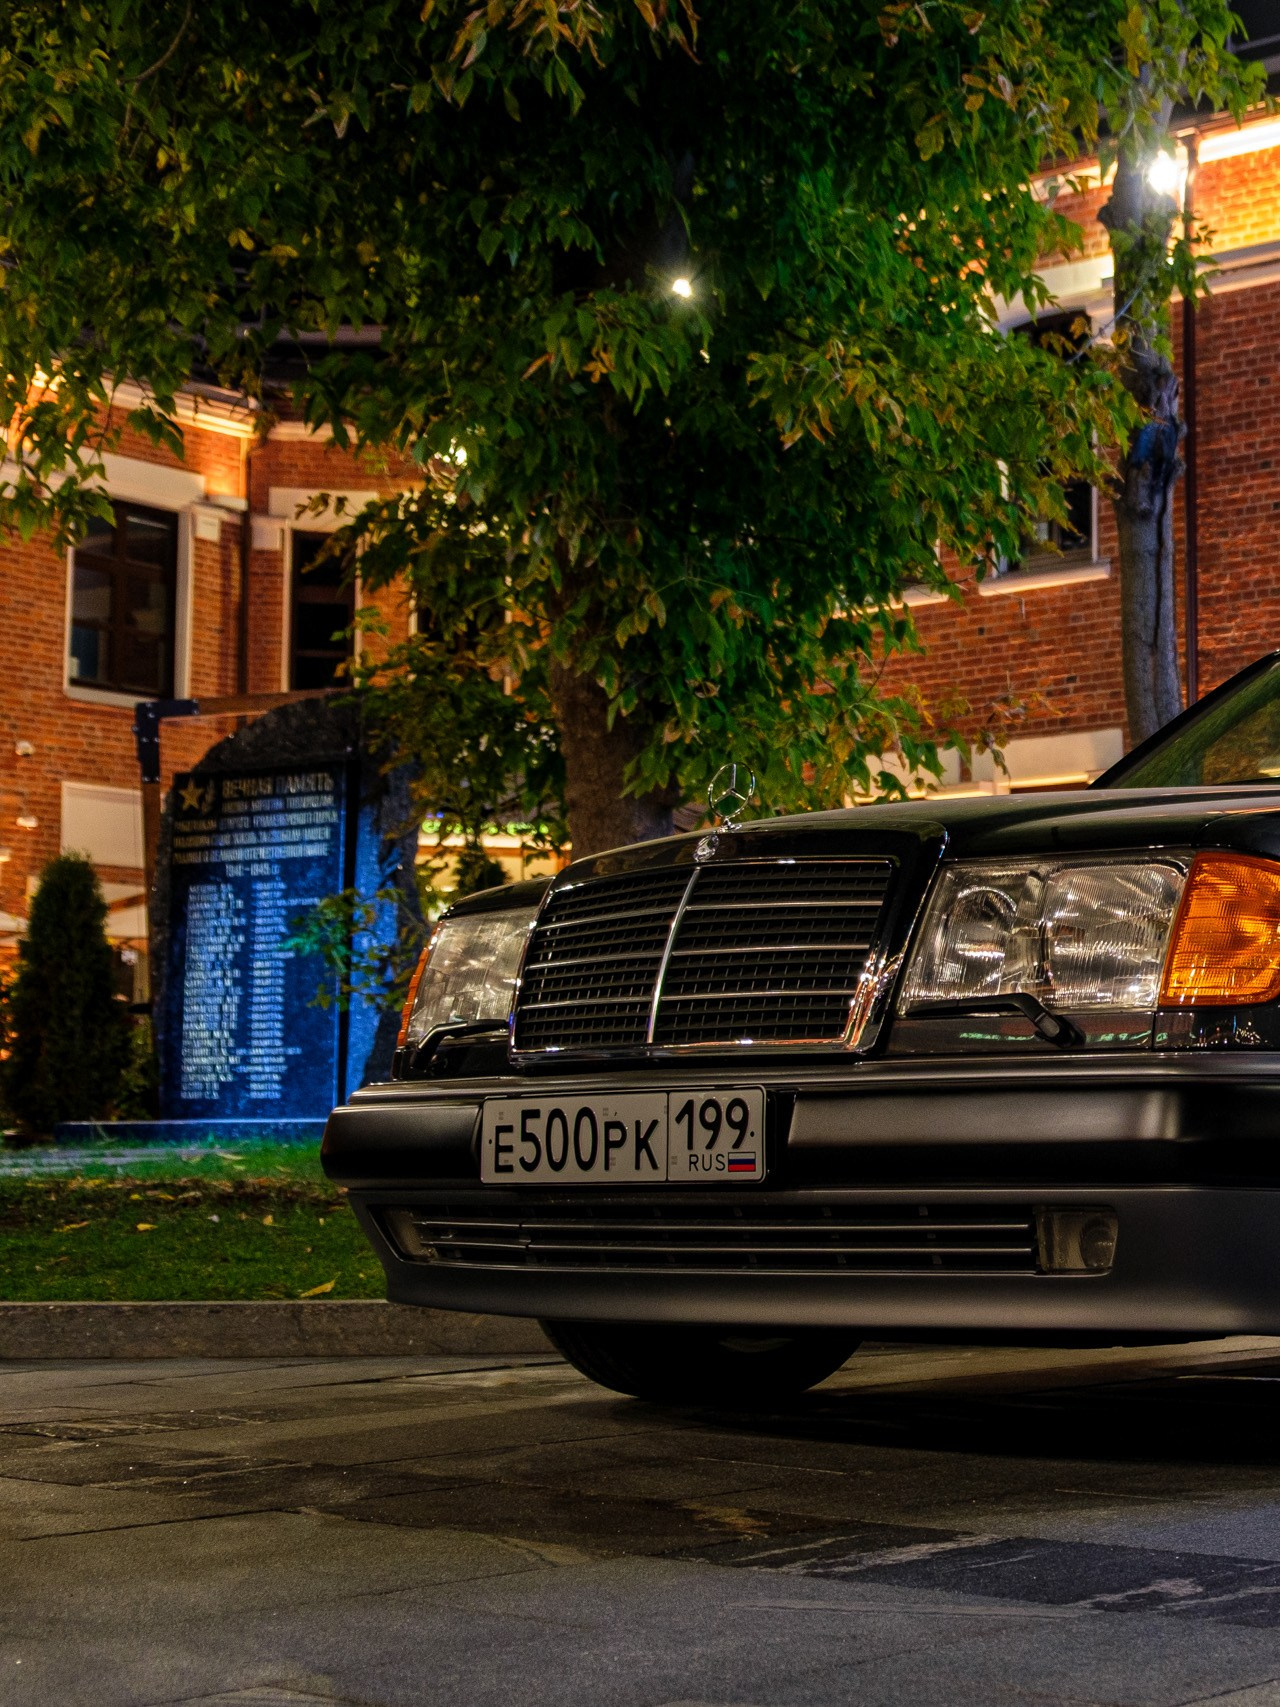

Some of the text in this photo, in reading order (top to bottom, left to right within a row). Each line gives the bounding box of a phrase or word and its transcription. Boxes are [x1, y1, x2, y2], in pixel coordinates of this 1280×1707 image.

[494, 1097, 750, 1173] Е500РК 199
[688, 1153, 726, 1172] RUS
